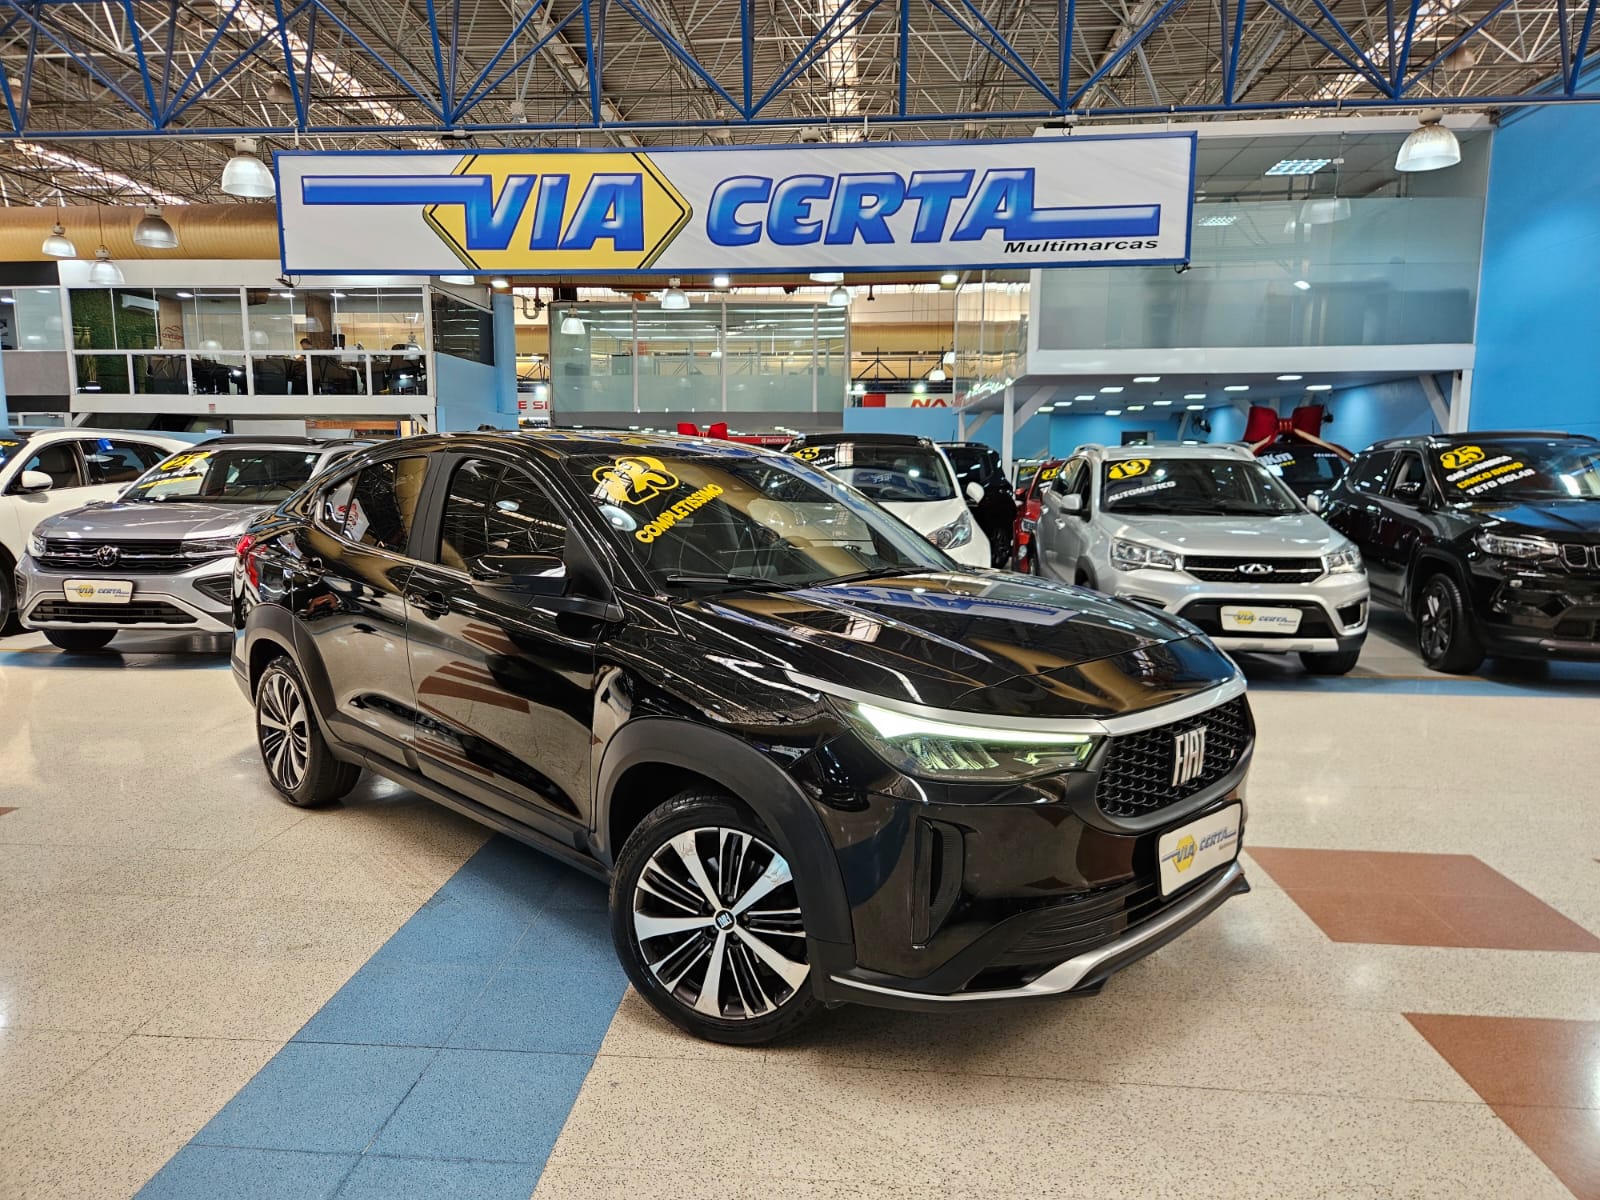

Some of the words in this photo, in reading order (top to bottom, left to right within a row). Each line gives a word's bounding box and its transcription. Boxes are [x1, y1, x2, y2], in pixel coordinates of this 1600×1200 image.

[464, 173, 645, 252] VIA
[705, 167, 1036, 247] CERTA
[1003, 238, 1159, 255] Multimarcas
[1109, 459, 1151, 479] 19
[1440, 445, 1486, 469] 25
[1107, 480, 1177, 502] AUTOMATICO
[1465, 480, 1498, 496] TETO
[1496, 468, 1536, 485] SOLAR
[635, 483, 724, 544] COMPLETISSIMO
[1172, 725, 1207, 787] FIAT
[1199, 827, 1229, 852] CERTA
